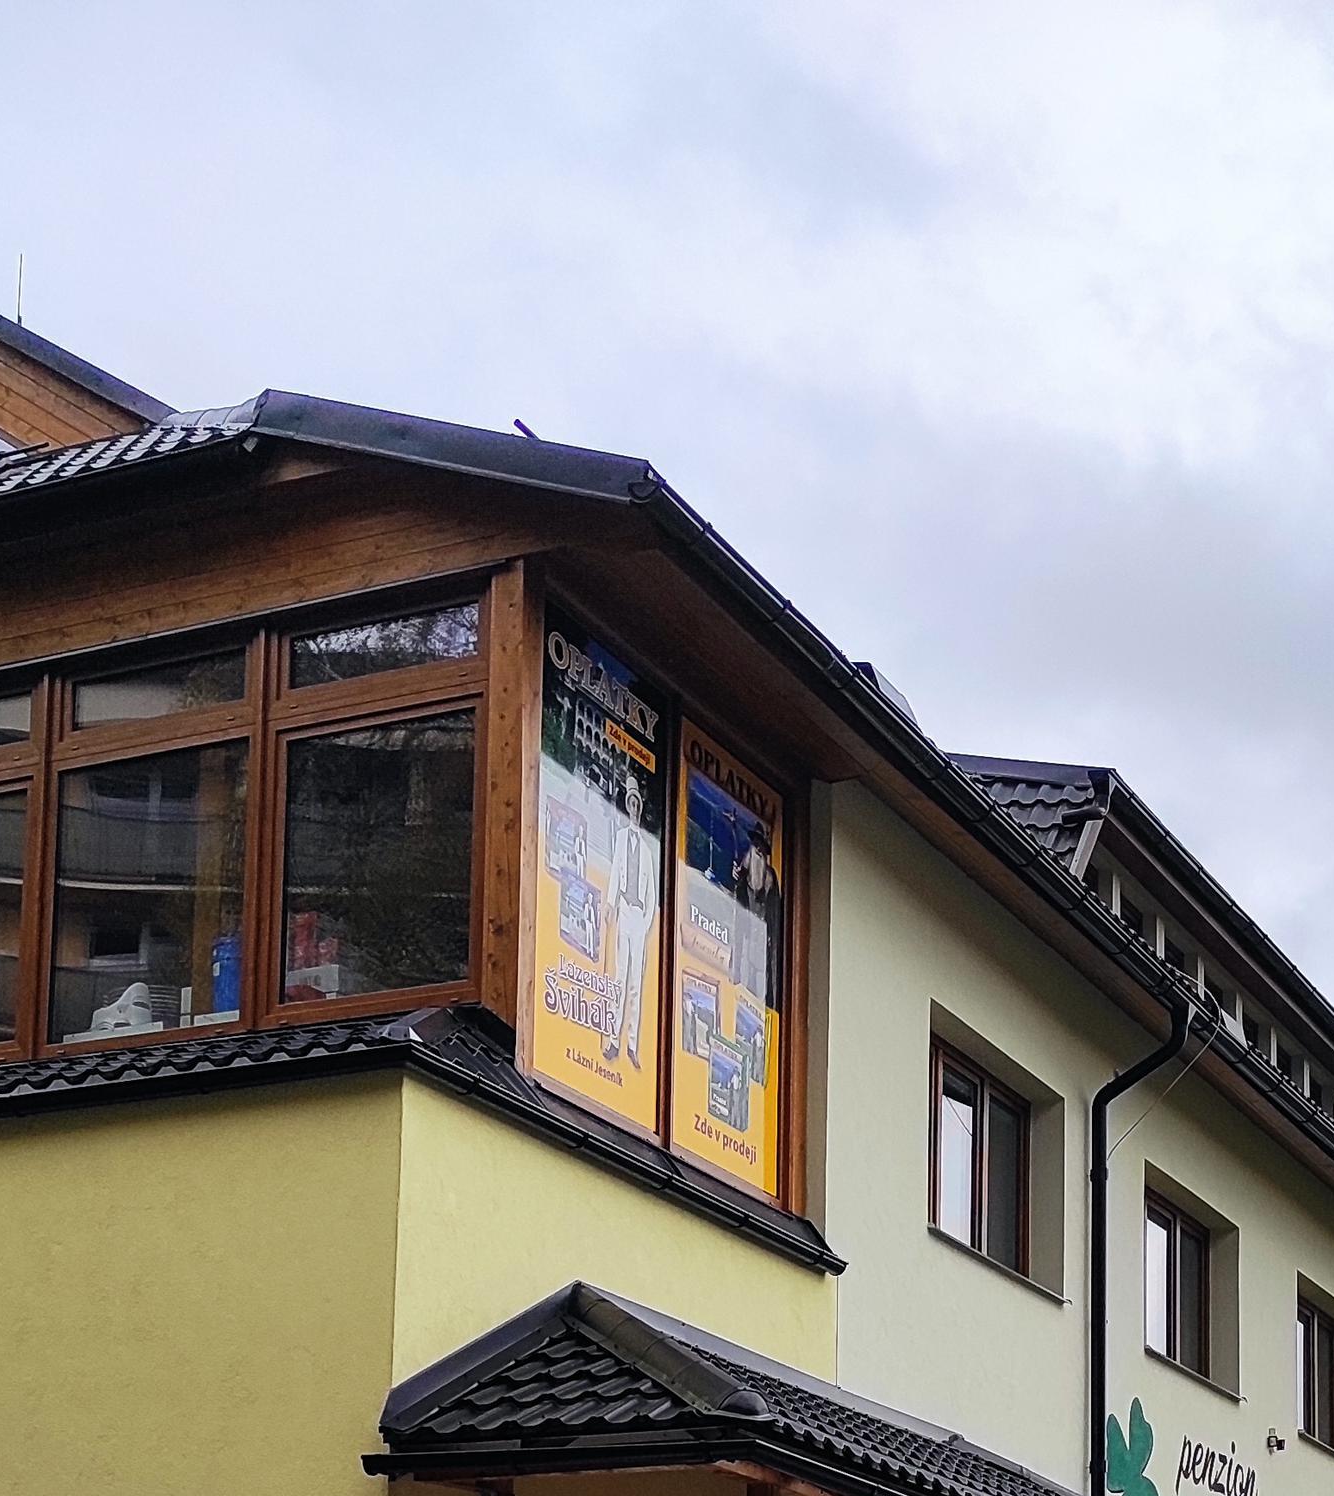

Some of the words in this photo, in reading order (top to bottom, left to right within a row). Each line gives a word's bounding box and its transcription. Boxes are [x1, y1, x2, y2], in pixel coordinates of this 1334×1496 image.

[548, 631, 659, 742] OPLATKY
[689, 739, 767, 813] OPLATKY
[690, 904, 729, 945] Praděd
[558, 953, 622, 1000] Lázeňský
[544, 967, 619, 1038] Švihák
[565, 1049, 571, 1058] z
[594, 1060, 623, 1087] Jeseník
[694, 1114, 713, 1140] Zde
[714, 1129, 721, 1142] v
[722, 1133, 757, 1163] prodeji
